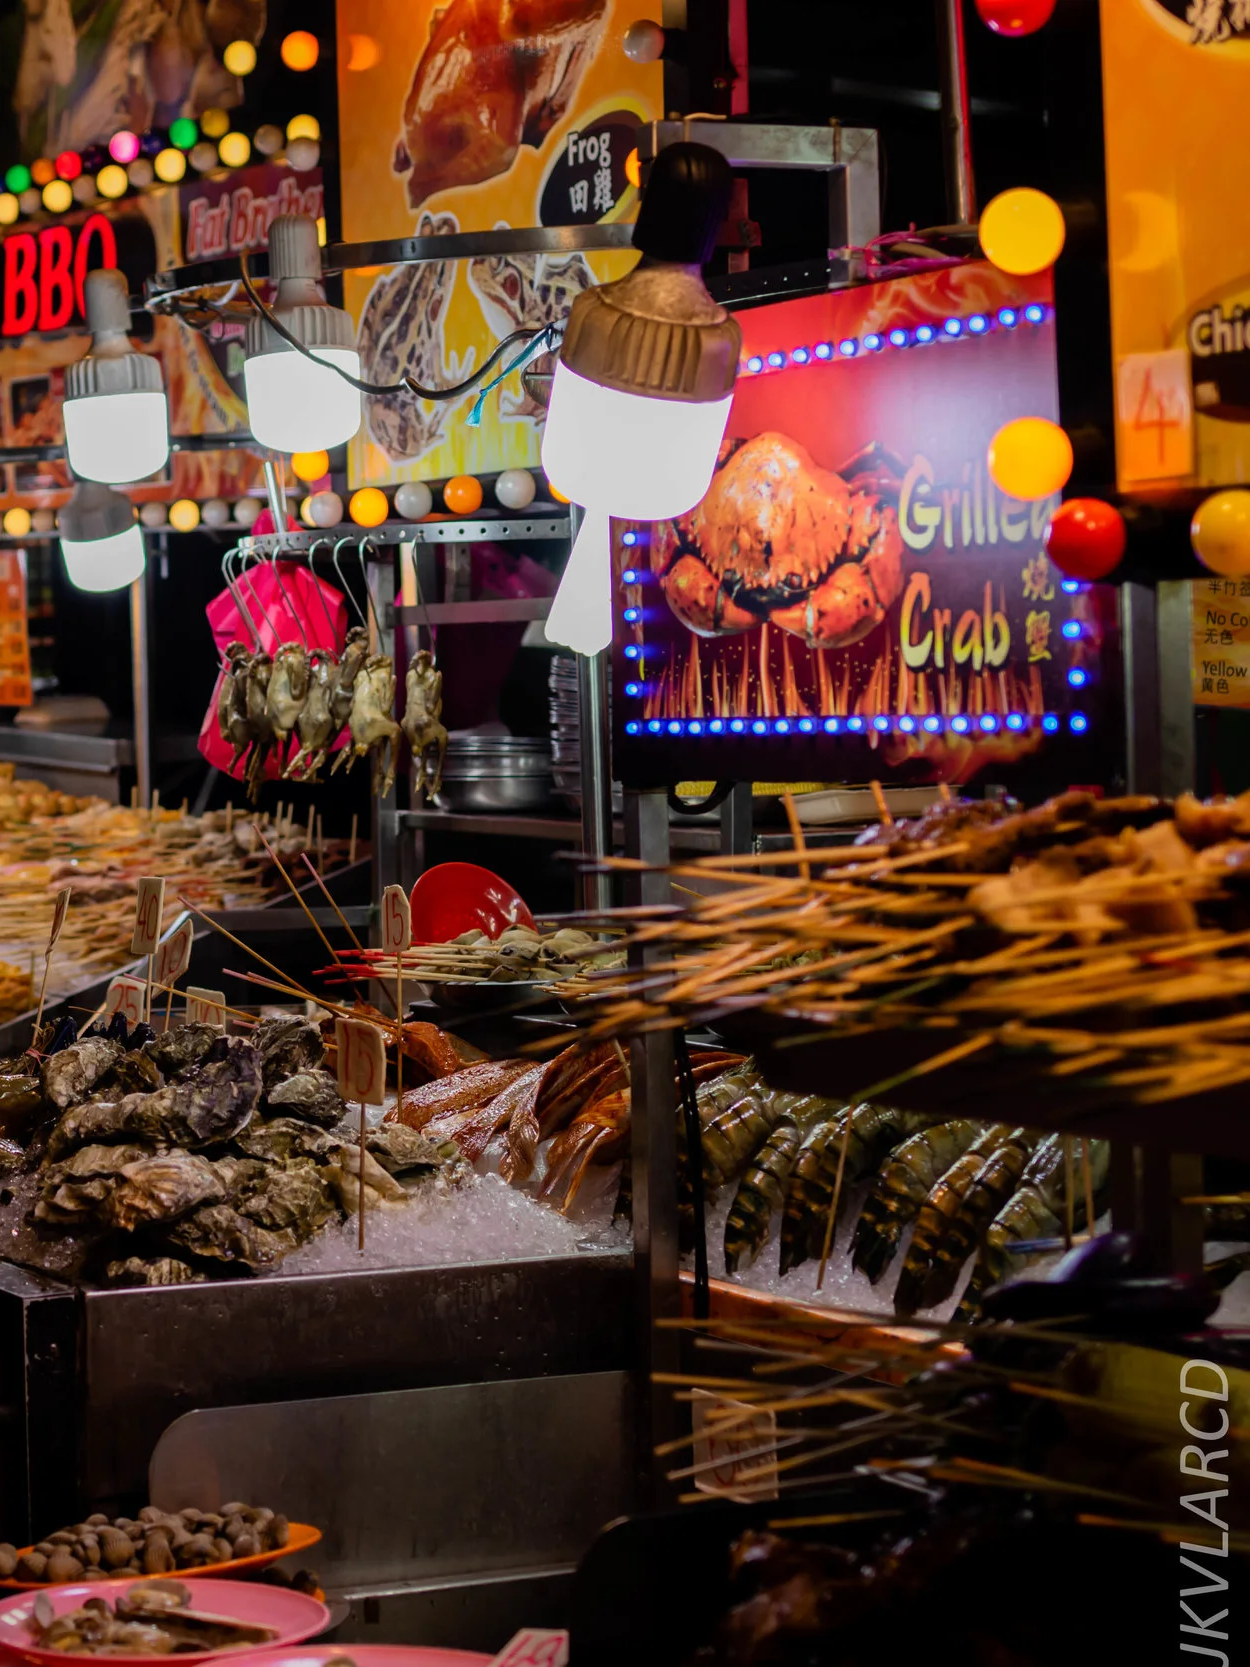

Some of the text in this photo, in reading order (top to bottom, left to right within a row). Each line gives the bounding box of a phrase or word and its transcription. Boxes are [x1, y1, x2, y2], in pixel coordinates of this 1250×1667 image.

[567, 131, 612, 168] Frog
[187, 196, 230, 260] Fat
[1134, 366, 1179, 468] 4
[900, 572, 1012, 672] Crab
[1205, 611, 1226, 626] No
[1201, 660, 1248, 678] Yellow
[137, 886, 159, 942] 40
[384, 892, 405, 947] 15
[160, 931, 188, 981] 10
[342, 1022, 375, 1097] 15
